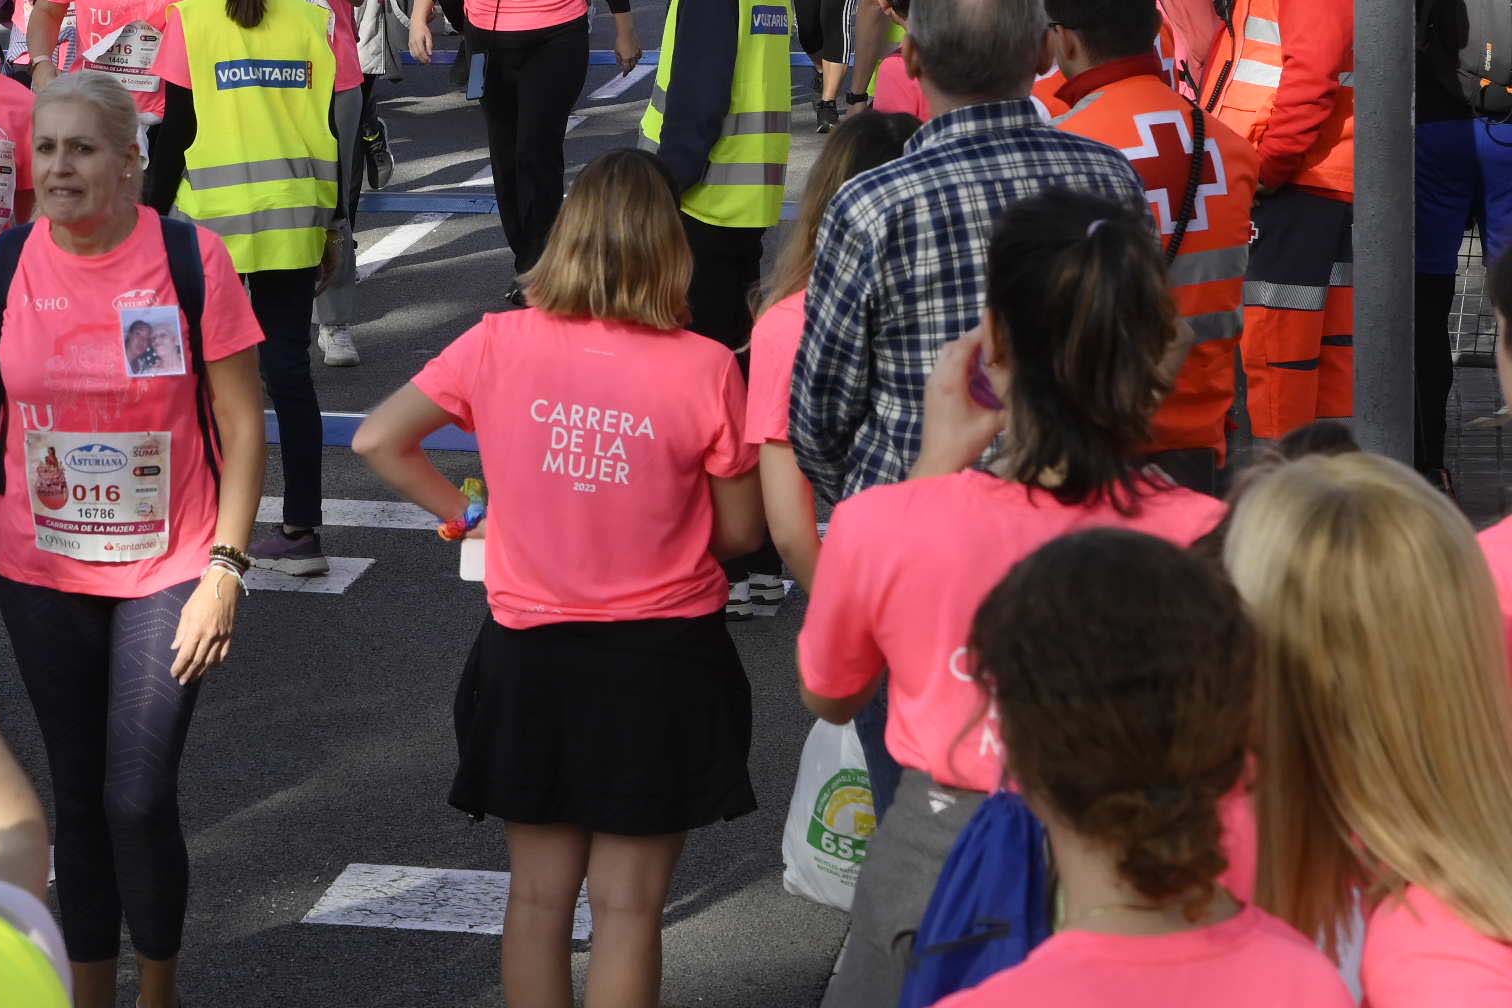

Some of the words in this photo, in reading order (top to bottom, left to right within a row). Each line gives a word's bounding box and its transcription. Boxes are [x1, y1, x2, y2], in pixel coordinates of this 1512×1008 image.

[88, 7, 112, 26] TU
[218, 66, 306, 82] VOLUNTARIS
[15, 400, 55, 433] TU
[529, 398, 656, 440] CARRERA
[551, 426, 585, 453] DE
[594, 433, 627, 460] LA
[69, 455, 123, 467] ASTURIANA
[541, 449, 630, 485] MUJER
[72, 483, 121, 503] 016
[77, 508, 116, 520] 16786
[45, 518, 80, 531] CARRERA
[81, 523, 92, 532] DE
[94, 524, 105, 532] LA
[106, 523, 135, 532] MUJER
[114, 539, 157, 552] Santander
